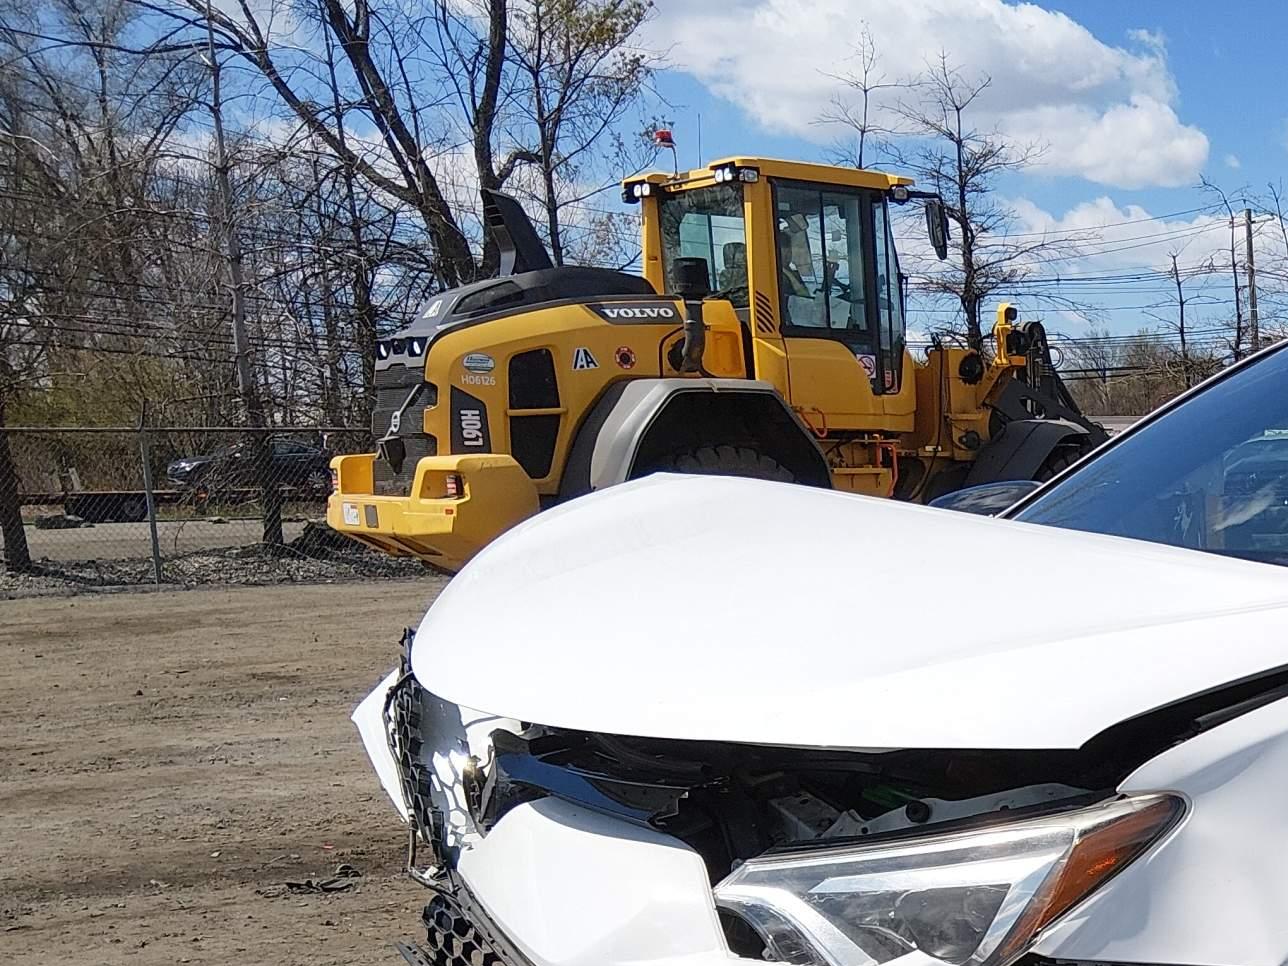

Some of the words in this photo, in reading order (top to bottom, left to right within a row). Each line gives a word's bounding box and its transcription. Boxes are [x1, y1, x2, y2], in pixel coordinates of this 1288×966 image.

[602, 308, 674, 318] VOLVO
[461, 375, 496, 385] H06126
[460, 410, 483, 446] L90H
